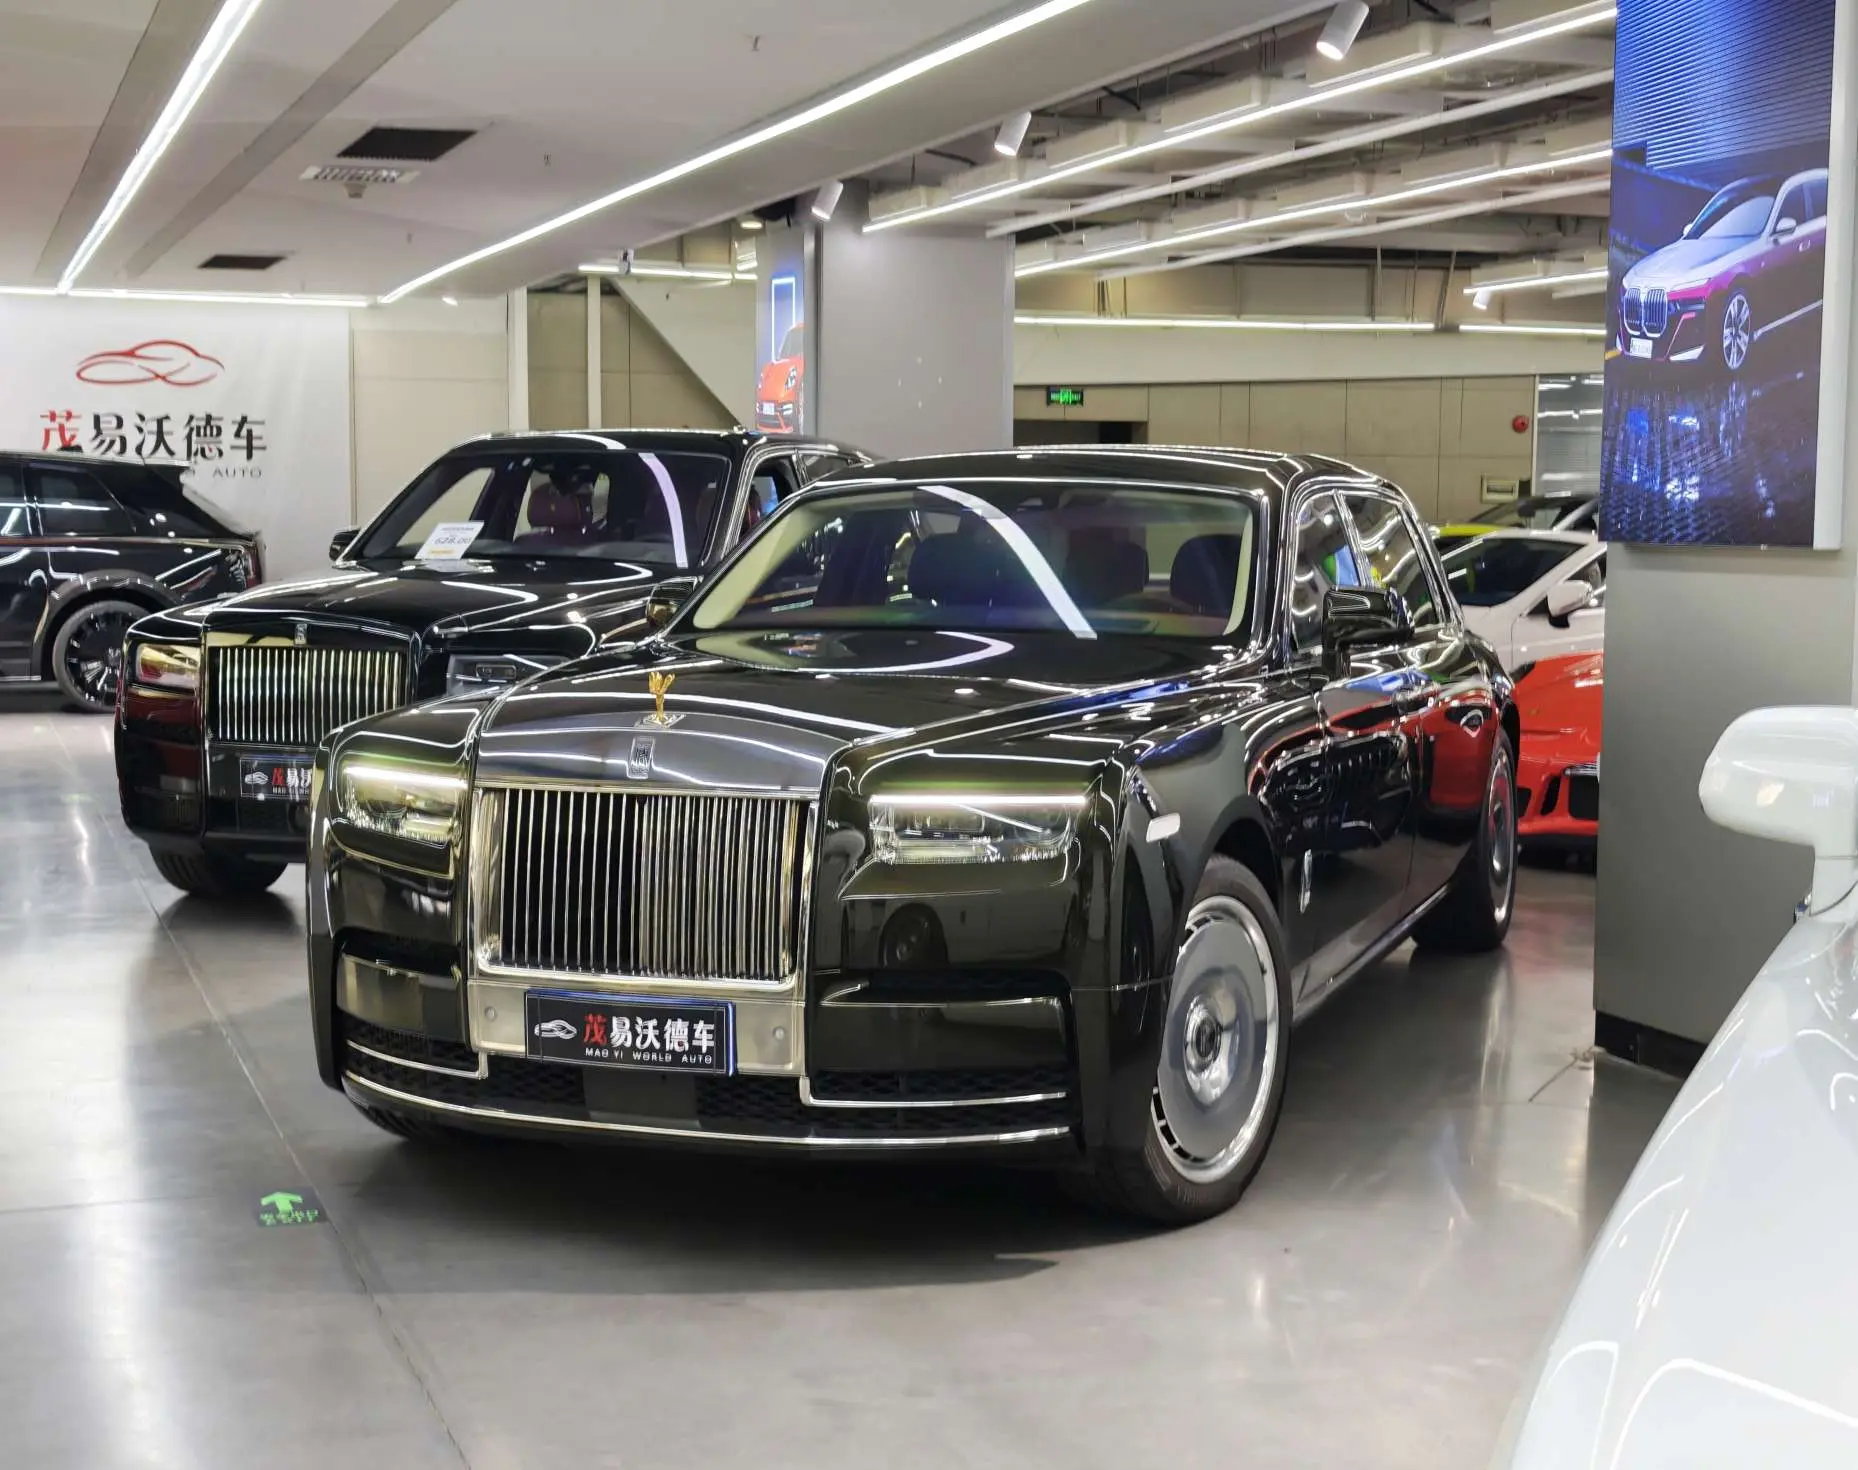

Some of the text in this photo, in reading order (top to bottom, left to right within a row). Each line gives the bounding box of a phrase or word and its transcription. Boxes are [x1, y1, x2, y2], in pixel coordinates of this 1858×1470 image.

[40, 410, 267, 461] 茂易沃德车
[212, 466, 262, 478] AUTO
[583, 1013, 715, 1053] 茂易沃德车
[585, 1047, 713, 1064] MAO YI WORLD AUTO
